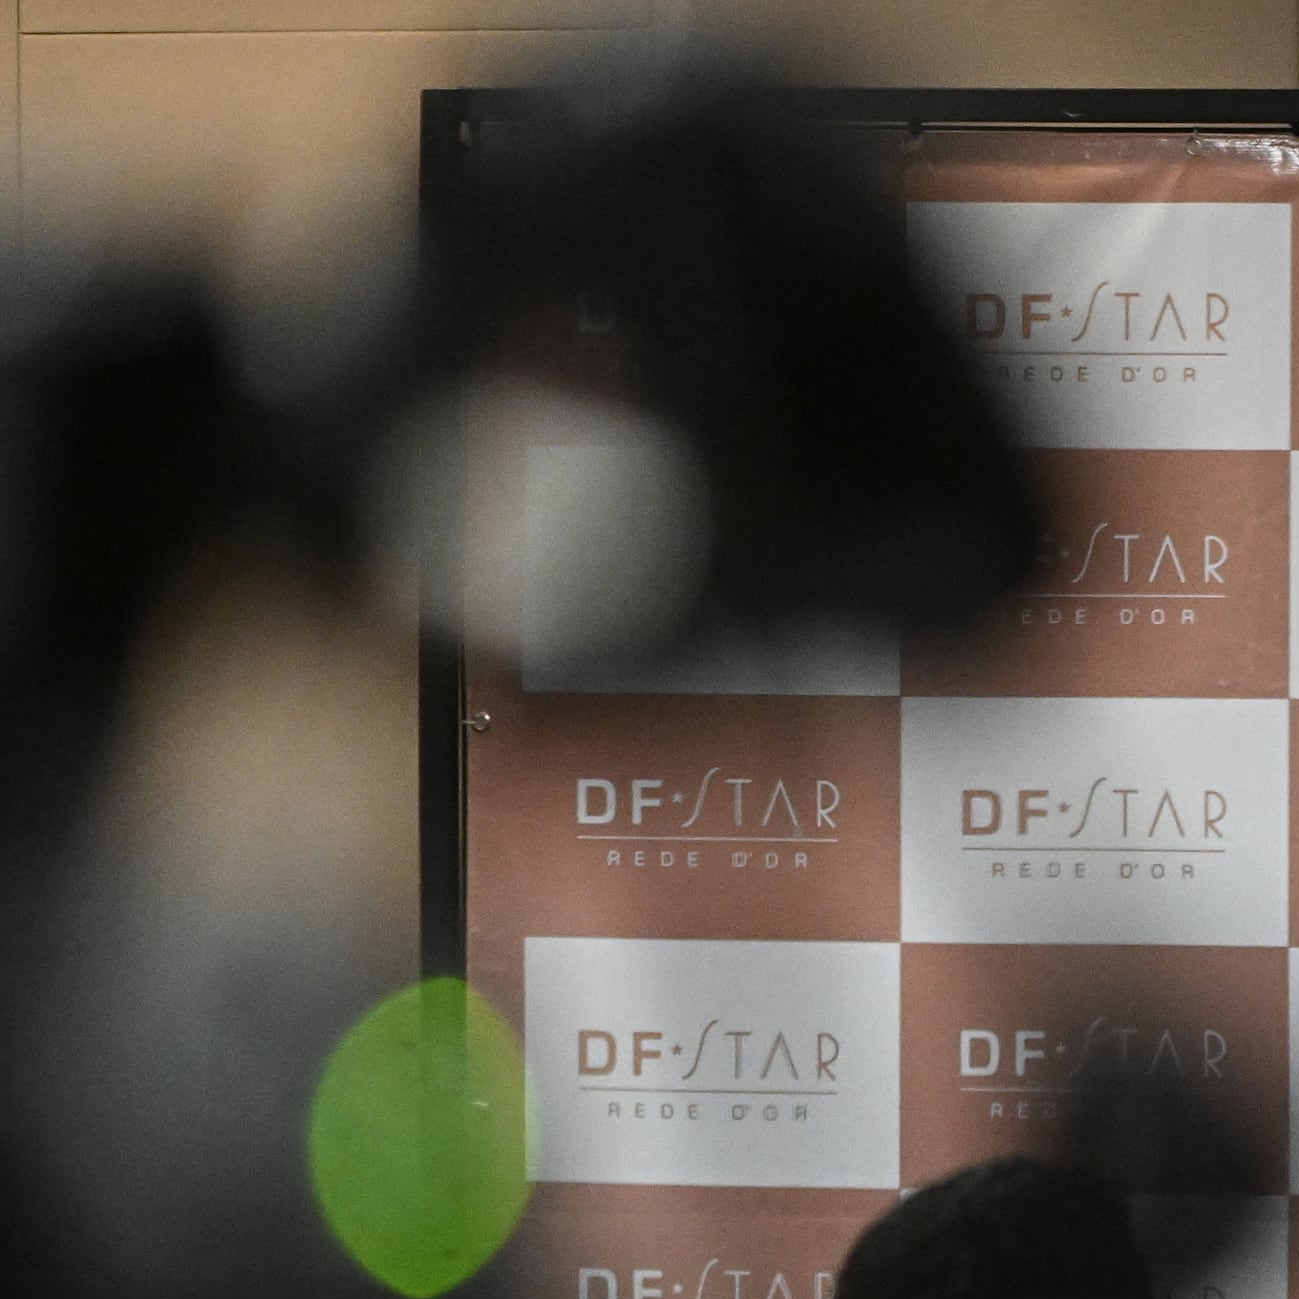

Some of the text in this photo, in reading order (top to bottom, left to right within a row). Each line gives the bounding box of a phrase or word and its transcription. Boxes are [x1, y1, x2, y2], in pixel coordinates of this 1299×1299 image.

[966, 281, 1230, 341] DF STAR
[1071, 522, 1228, 583] STAR
[1022, 608, 1087, 624] EDE
[577, 767, 840, 829] DF STAR
[962, 777, 1226, 839] DF STAR
[578, 1019, 839, 1080] DF STAR
[960, 1029, 1046, 1077] DF
